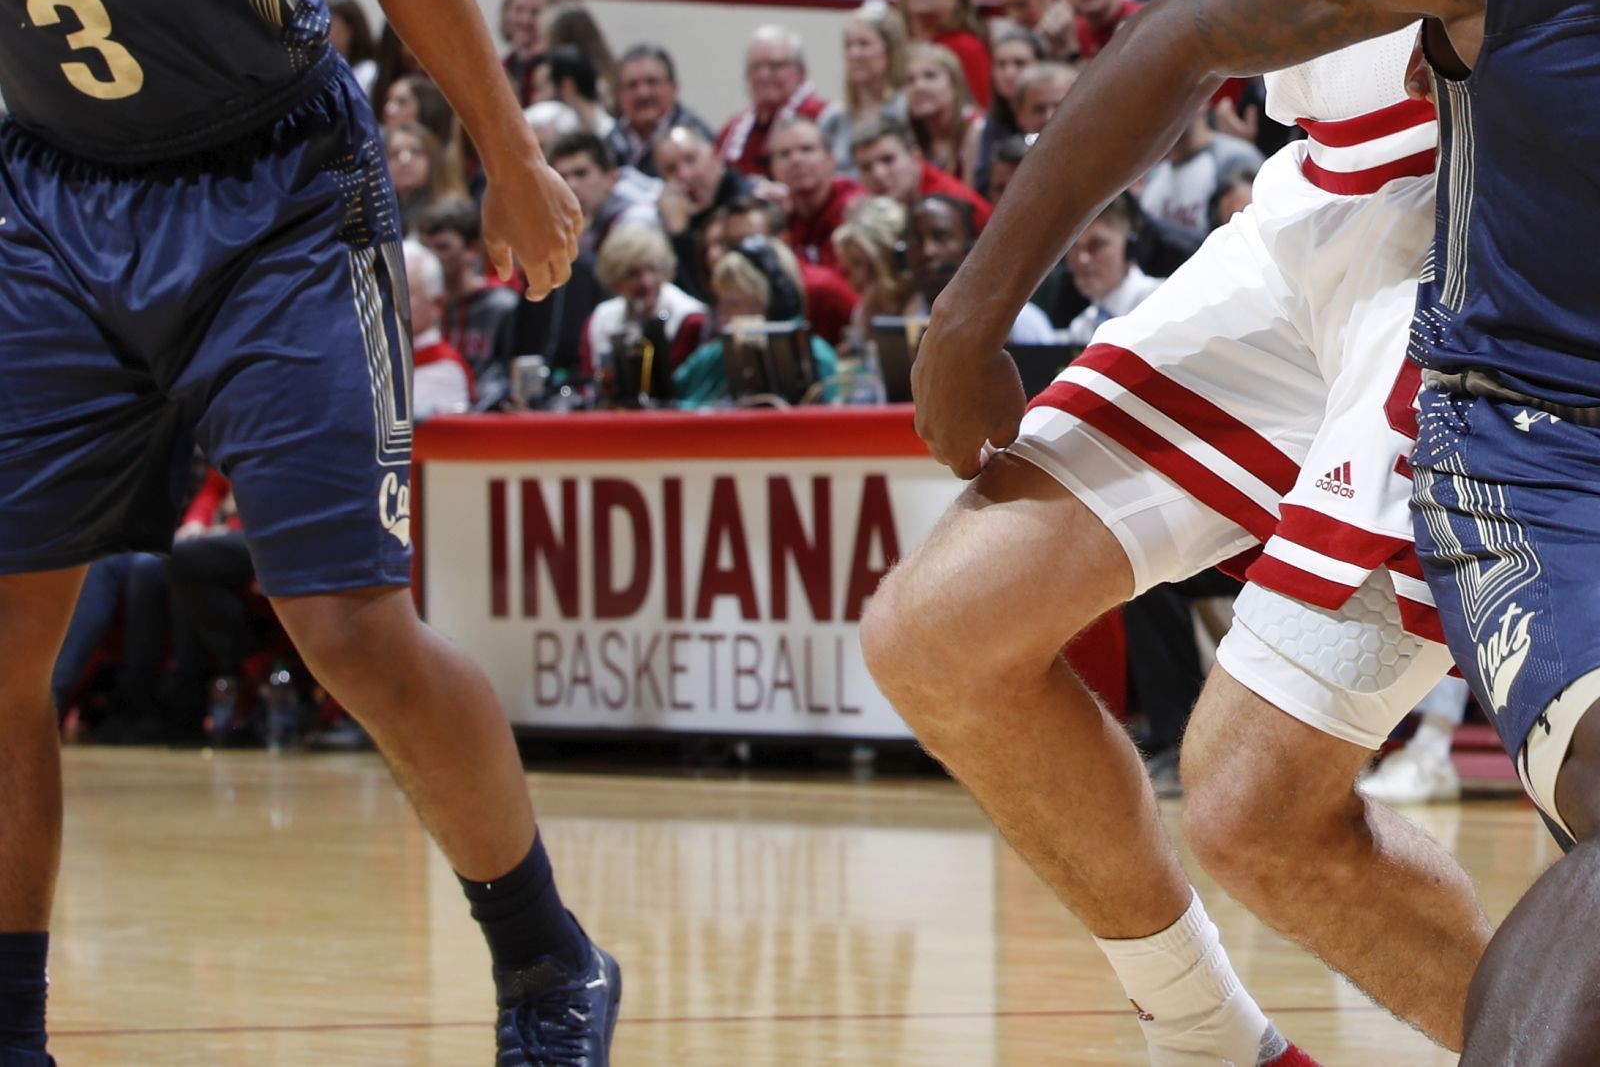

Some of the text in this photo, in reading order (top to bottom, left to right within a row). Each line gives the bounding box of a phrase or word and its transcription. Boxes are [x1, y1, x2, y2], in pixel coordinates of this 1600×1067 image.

[379, 472, 410, 529] Ca
[1315, 475, 1355, 499] adidas
[488, 474, 904, 622] INDIANA
[533, 630, 862, 716] BASKETBALL
[1477, 602, 1536, 714] Cats
